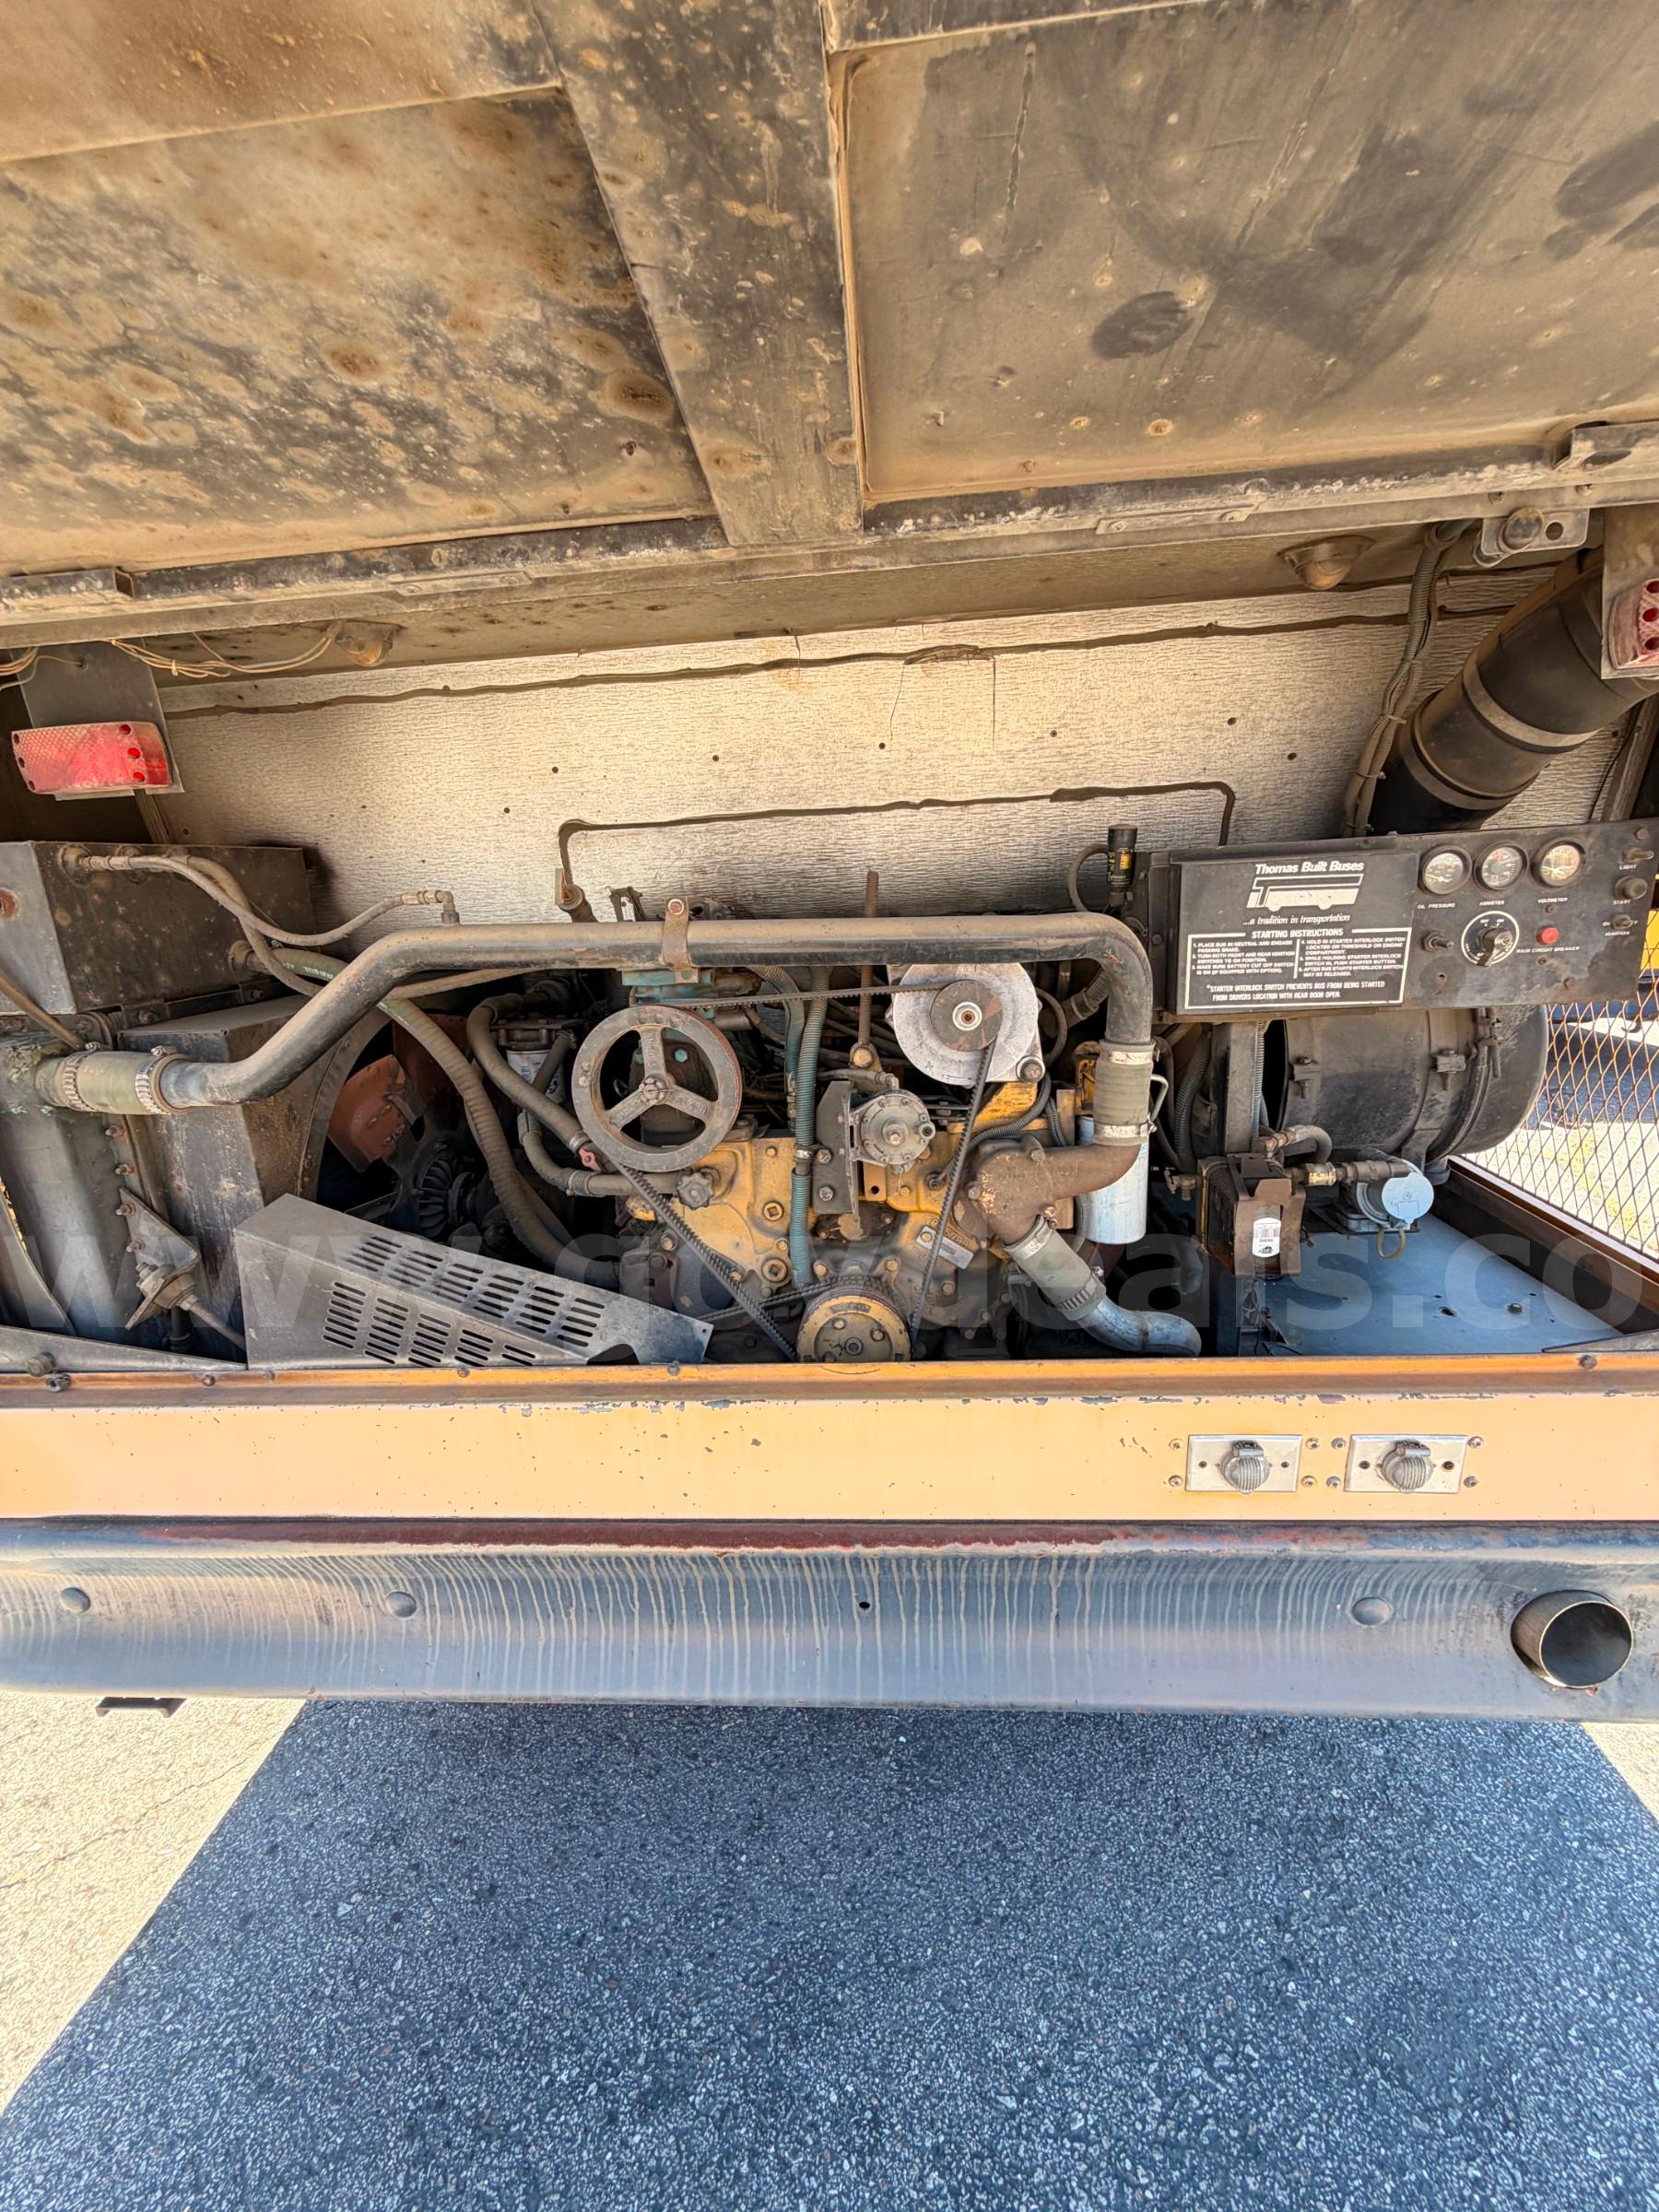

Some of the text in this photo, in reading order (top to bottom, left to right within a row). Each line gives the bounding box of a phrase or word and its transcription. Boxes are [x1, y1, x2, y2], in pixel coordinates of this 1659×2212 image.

[1254, 860, 1365, 875] Thomas Built Buses
[1257, 914, 1288, 925] tradition
[1289, 914, 1299, 924] in
[1300, 912, 1351, 925] transportation
[1251, 927, 1344, 939] STARTING INSTRUCTIONS
[1234, 983, 1263, 993] INTERLOCK
[1264, 983, 1285, 992] SWITCH
[1285, 982, 1313, 991] PREVENTS
[1313, 982, 1326, 990] BUS
[1343, 981, 1360, 989] BEING
[1360, 980, 1386, 988] STARTED
[1212, 994, 1229, 1003] FROM
[1229, 993, 1252, 1002] DRIVERS
[1252, 992, 1278, 1001] LOCATION
[1293, 991, 1309, 999] REAR
[1309, 991, 1324, 999] DOOR
